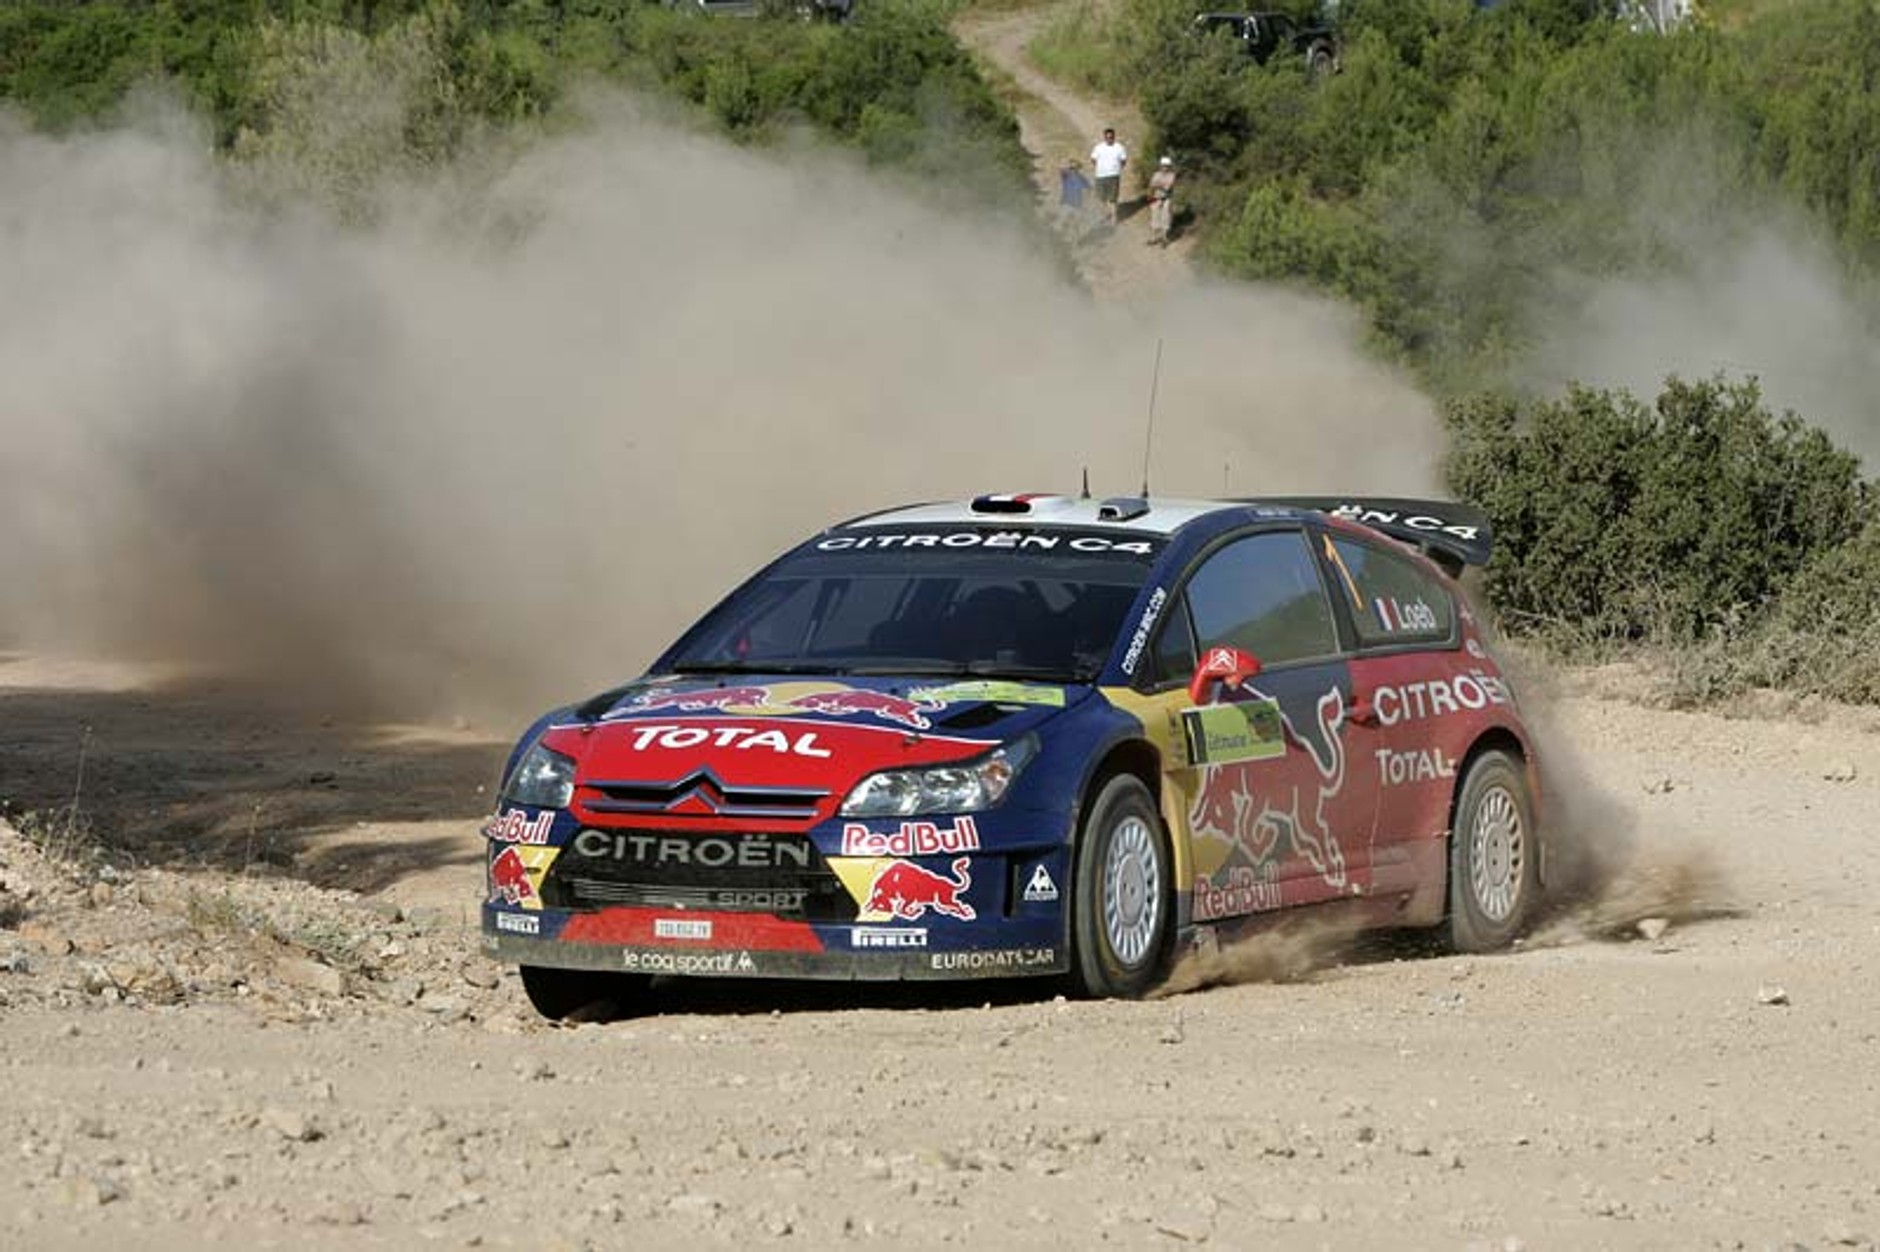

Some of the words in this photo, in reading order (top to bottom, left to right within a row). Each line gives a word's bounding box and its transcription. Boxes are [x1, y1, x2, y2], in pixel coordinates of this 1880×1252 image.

[818, 532, 1060, 549] CITROËN
[1071, 538, 1152, 554] C4
[1404, 516, 1479, 540] C4
[1322, 533, 1363, 611] 1
[1391, 596, 1437, 630] Loeb
[632, 725, 832, 758] TOTAL
[1375, 747, 1455, 787] TOTAL
[506, 810, 557, 844] Bull
[841, 822, 913, 856] Red
[913, 816, 981, 855] Bull
[574, 829, 811, 867] CITROËN
[716, 891, 808, 908] SPORT
[1192, 867, 1238, 922] Red
[1237, 862, 1282, 914] Bull
[851, 927, 928, 946] PIRELLI
[623, 949, 638, 967] le
[641, 954, 674, 972] coq
[677, 950, 735, 975] sportif
